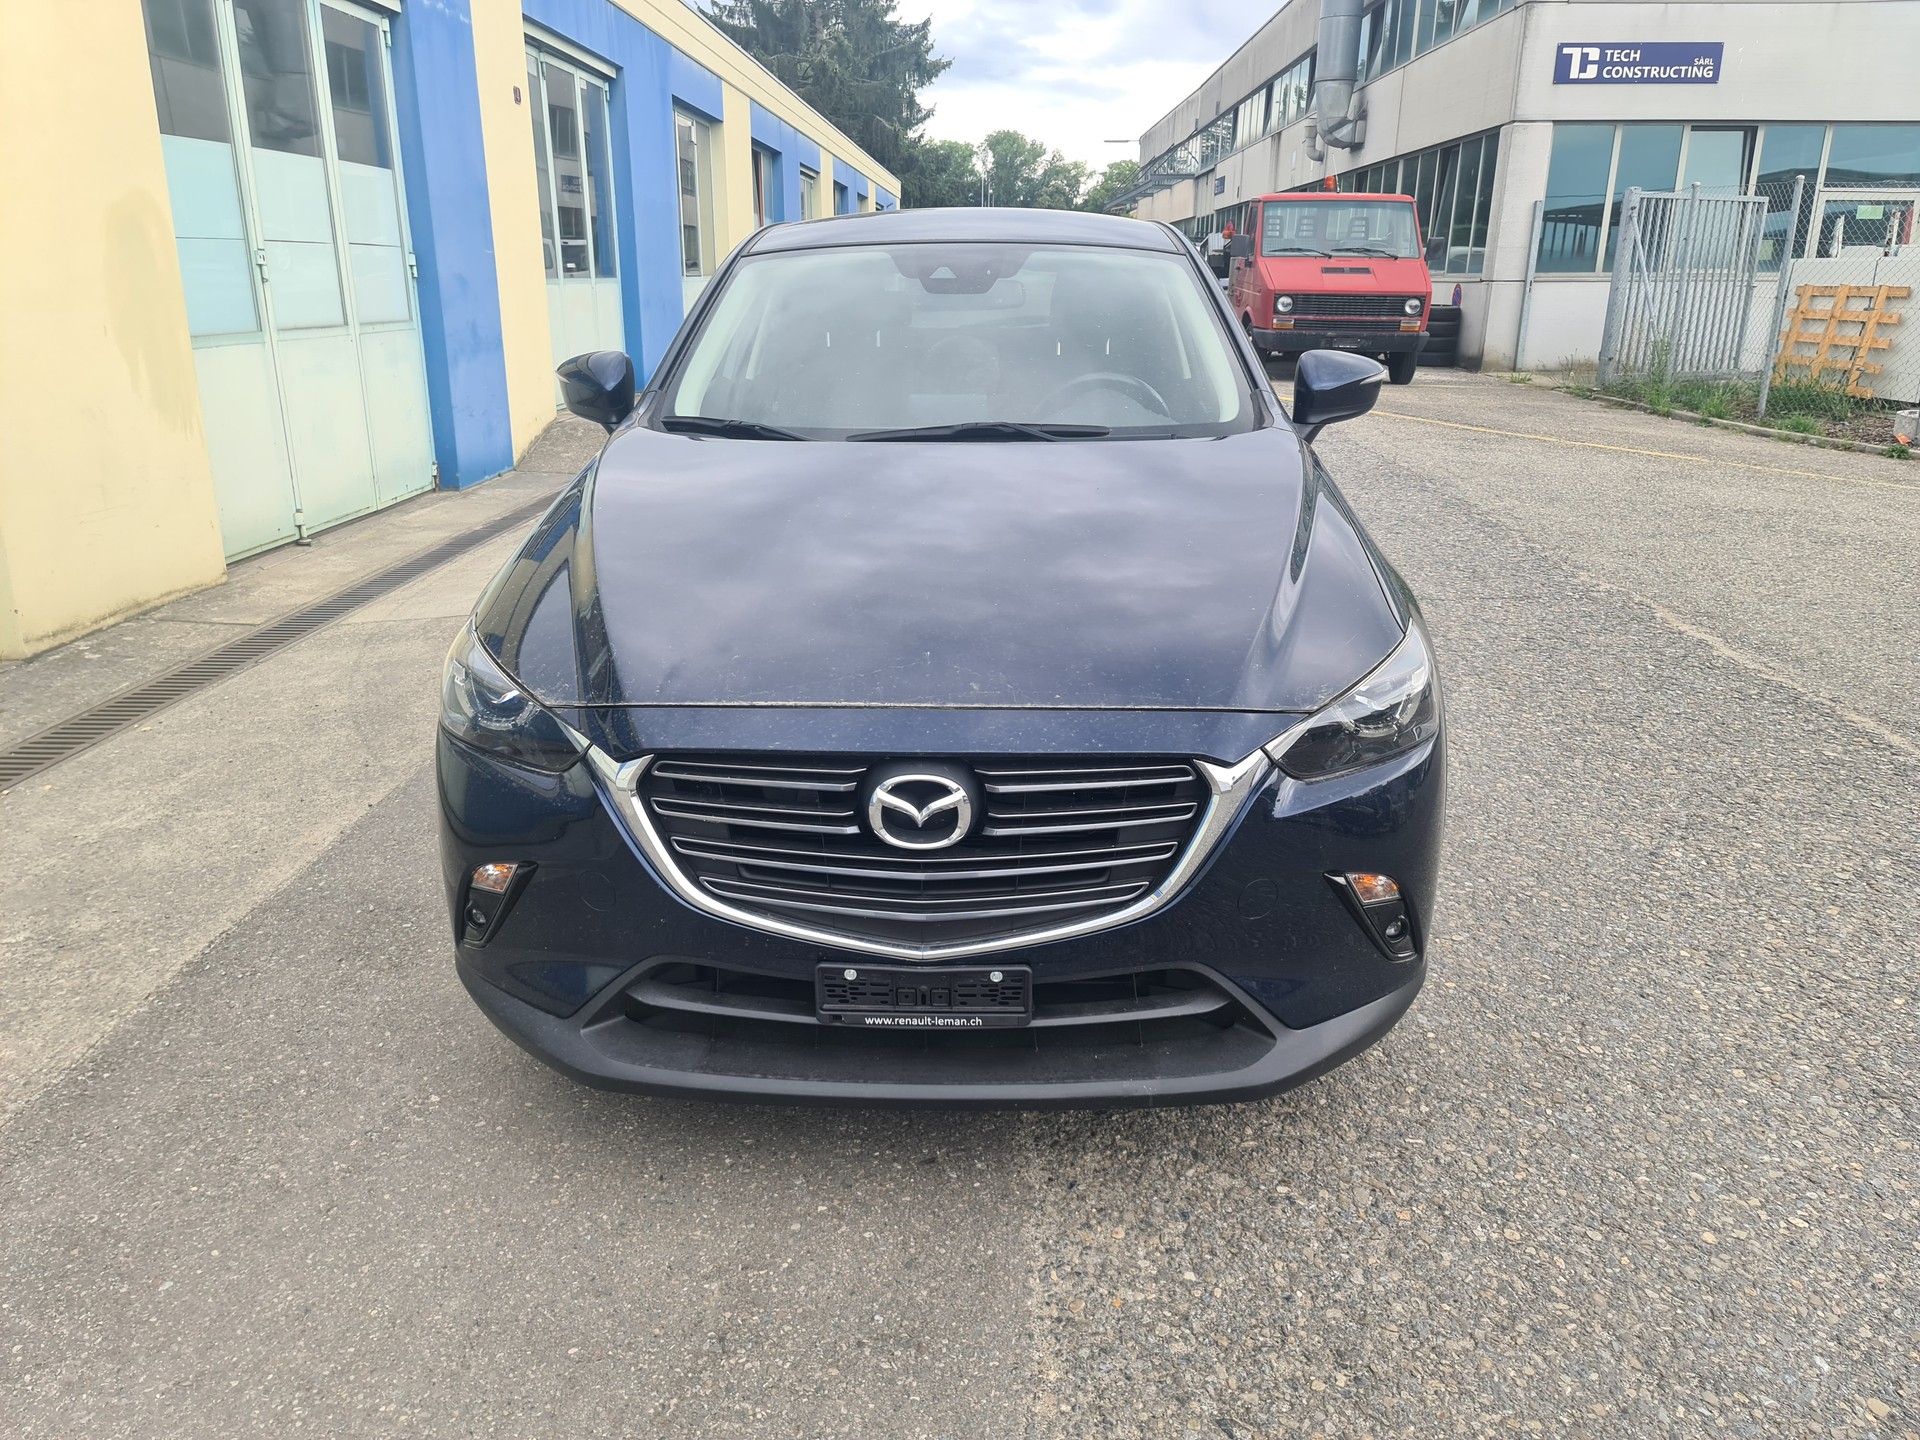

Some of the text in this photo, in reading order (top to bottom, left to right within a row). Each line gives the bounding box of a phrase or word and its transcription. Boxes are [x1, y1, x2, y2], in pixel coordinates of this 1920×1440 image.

[1605, 50, 1641, 62] TECH
[1603, 66, 1714, 79] CONSTRUCTING
[865, 1016, 983, 1026] www.renault-leman.ch
